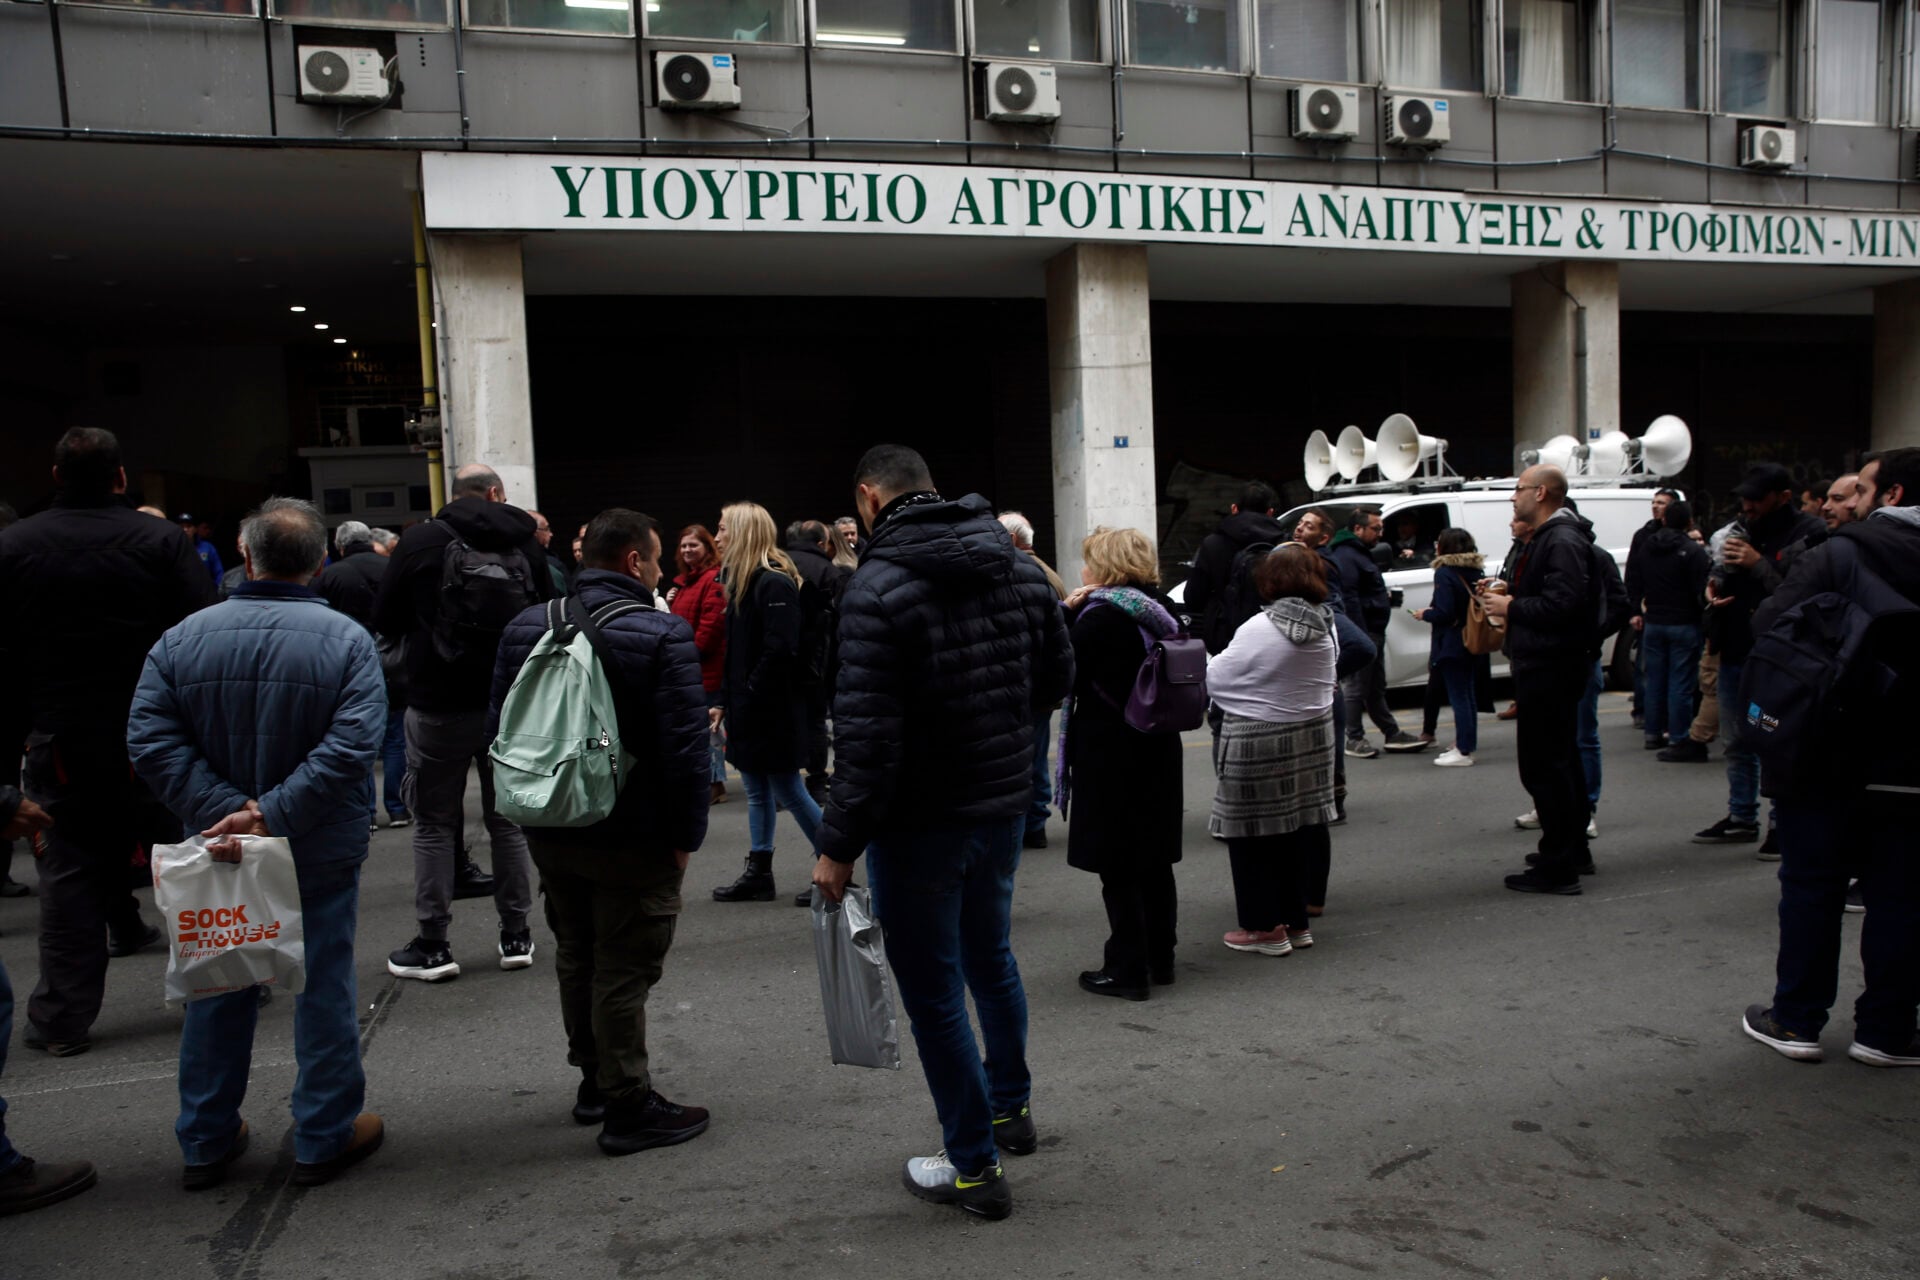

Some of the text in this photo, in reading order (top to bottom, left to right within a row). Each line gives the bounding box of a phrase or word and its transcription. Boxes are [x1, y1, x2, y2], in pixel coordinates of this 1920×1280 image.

[551, 165, 928, 225] ΥΠΟΥΡΓΕΙΟ
[948, 176, 1266, 236] ΑΓΡΟΤΙΚΗΣ
[1285, 192, 1564, 249] ΑΝΑΠΤΥΞΗΣ
[1575, 207, 1604, 250] &
[178, 904, 249, 931] SOCK
